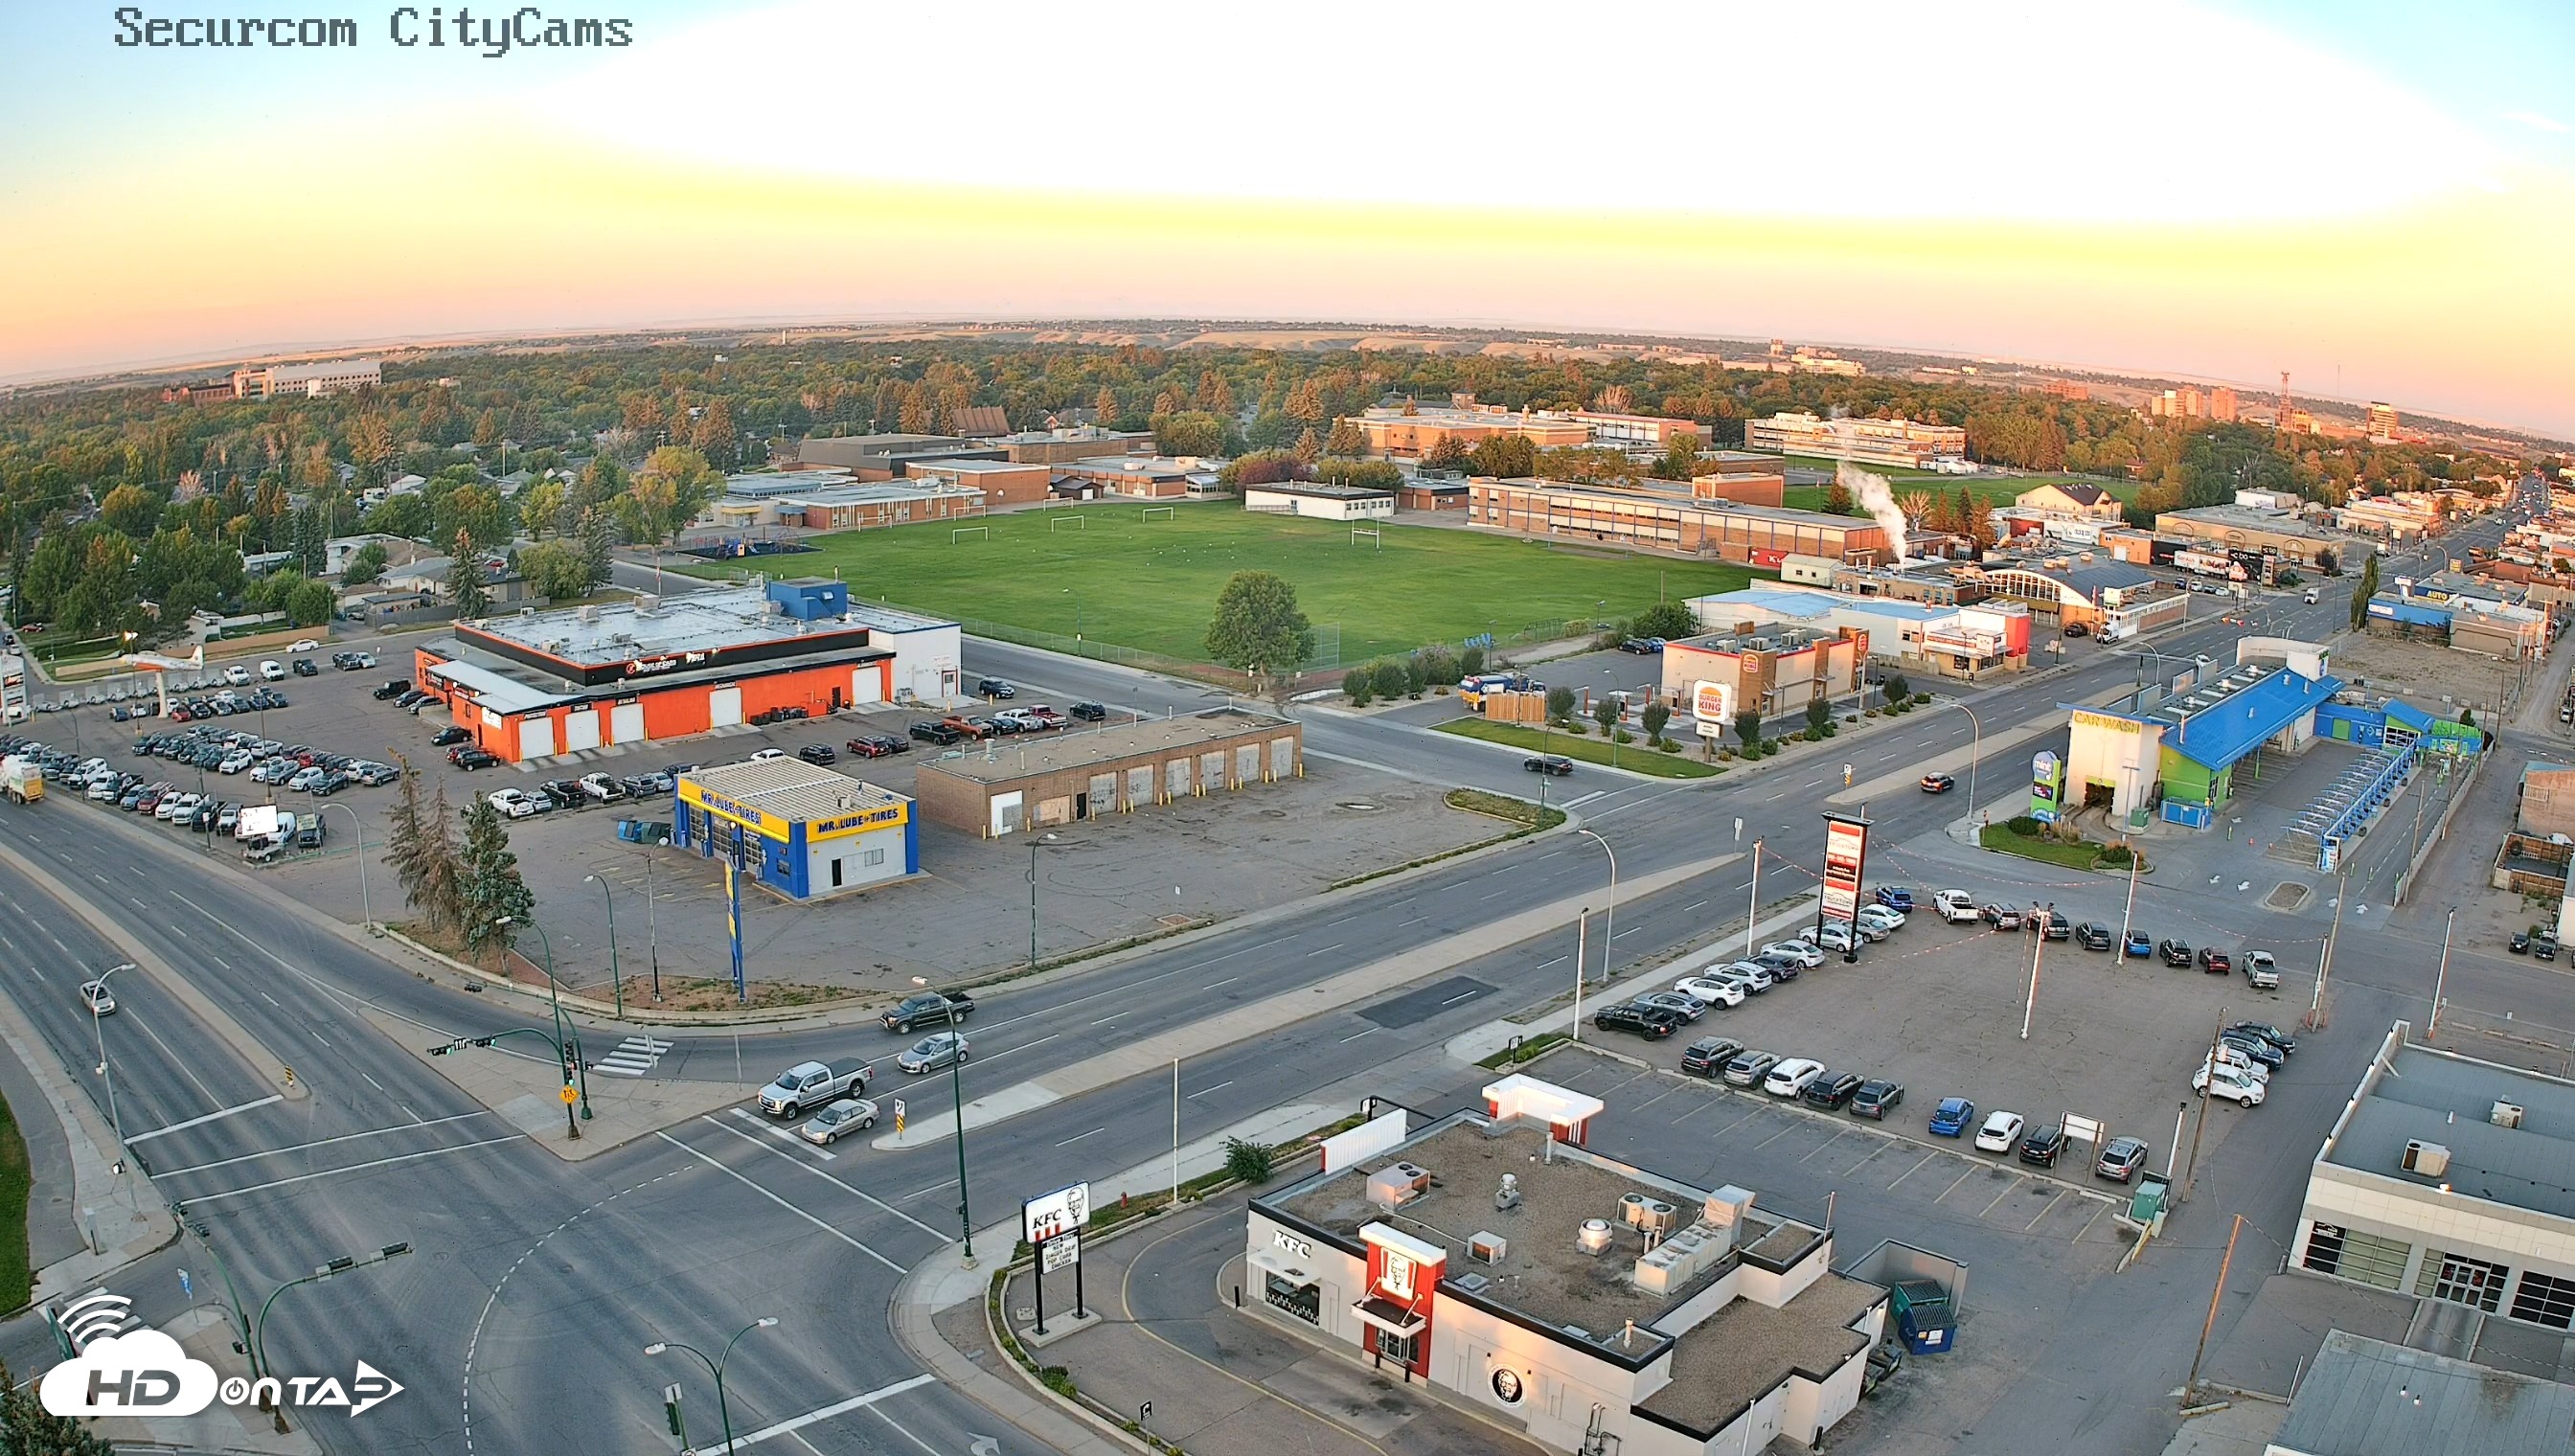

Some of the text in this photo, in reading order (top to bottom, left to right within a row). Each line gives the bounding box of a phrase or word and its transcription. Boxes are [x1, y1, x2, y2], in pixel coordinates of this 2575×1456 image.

[2427, 590, 2449, 601] AUTO
[1698, 694, 1721, 704] BURGER
[1698, 700, 1721, 712] KING
[2074, 712, 2140, 735] CAR WASH
[2034, 760, 2052, 772] mint
[716, 795, 735, 814] LUBE
[738, 805, 762, 826] TIRES
[839, 815, 863, 830] LUBE
[870, 808, 899, 823] TIRES
[1033, 1209, 1062, 1229] KFC
[1273, 1229, 1312, 1260] KFC
